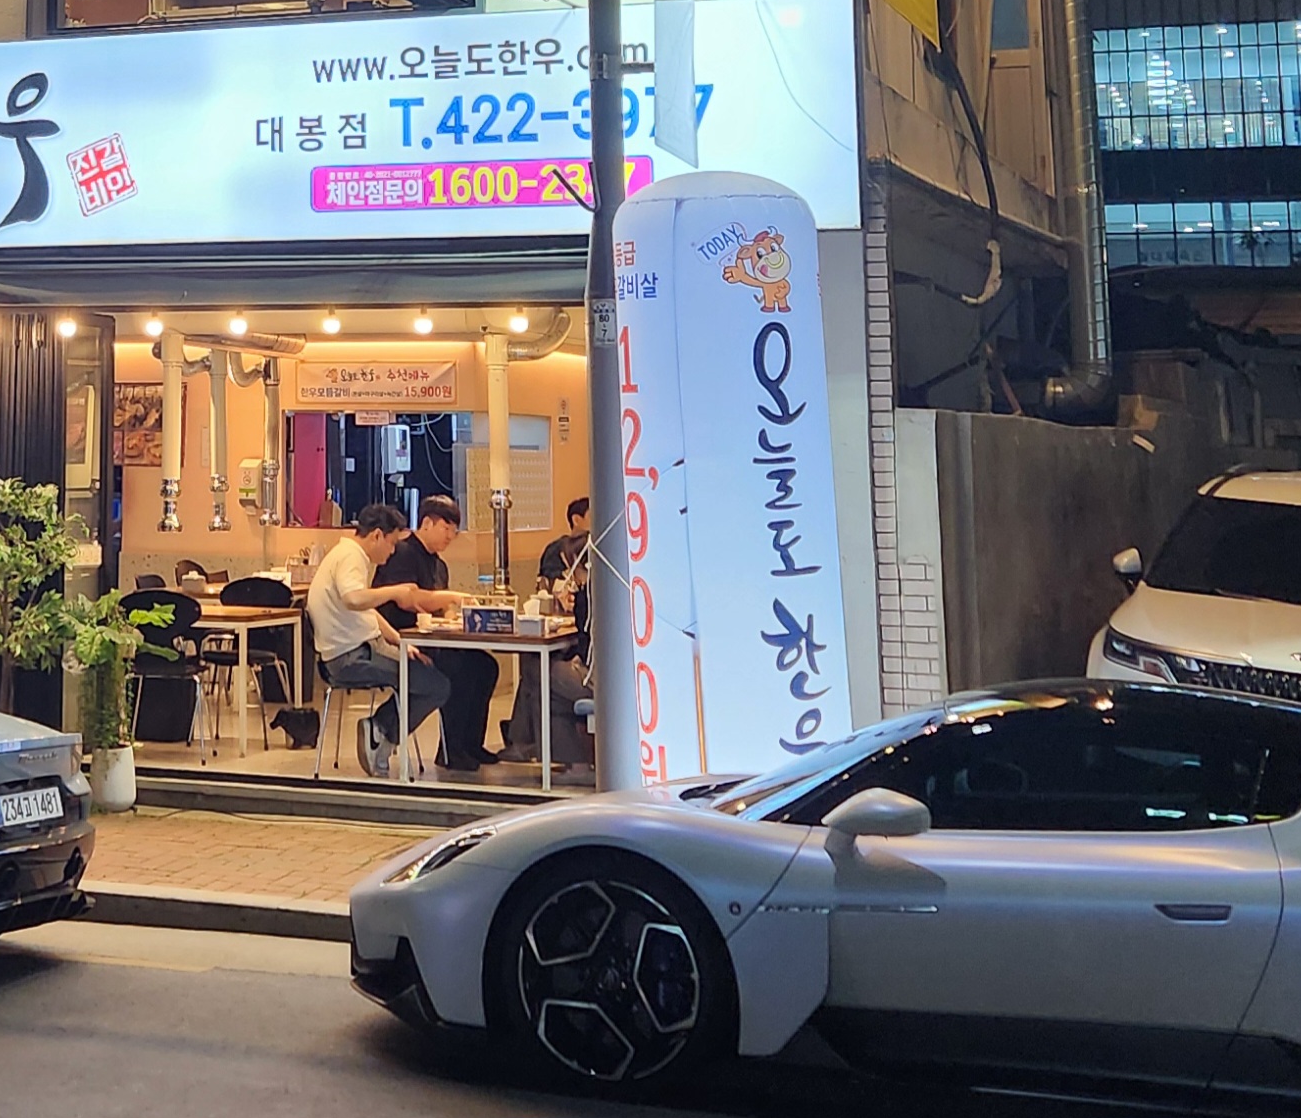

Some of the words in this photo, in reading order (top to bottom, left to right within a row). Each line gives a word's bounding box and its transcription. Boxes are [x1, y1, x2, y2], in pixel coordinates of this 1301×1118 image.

[326, 179, 423, 206] 체인점문의
[697, 224, 740, 262] TODAY
[752, 321, 823, 576] 오늘도
